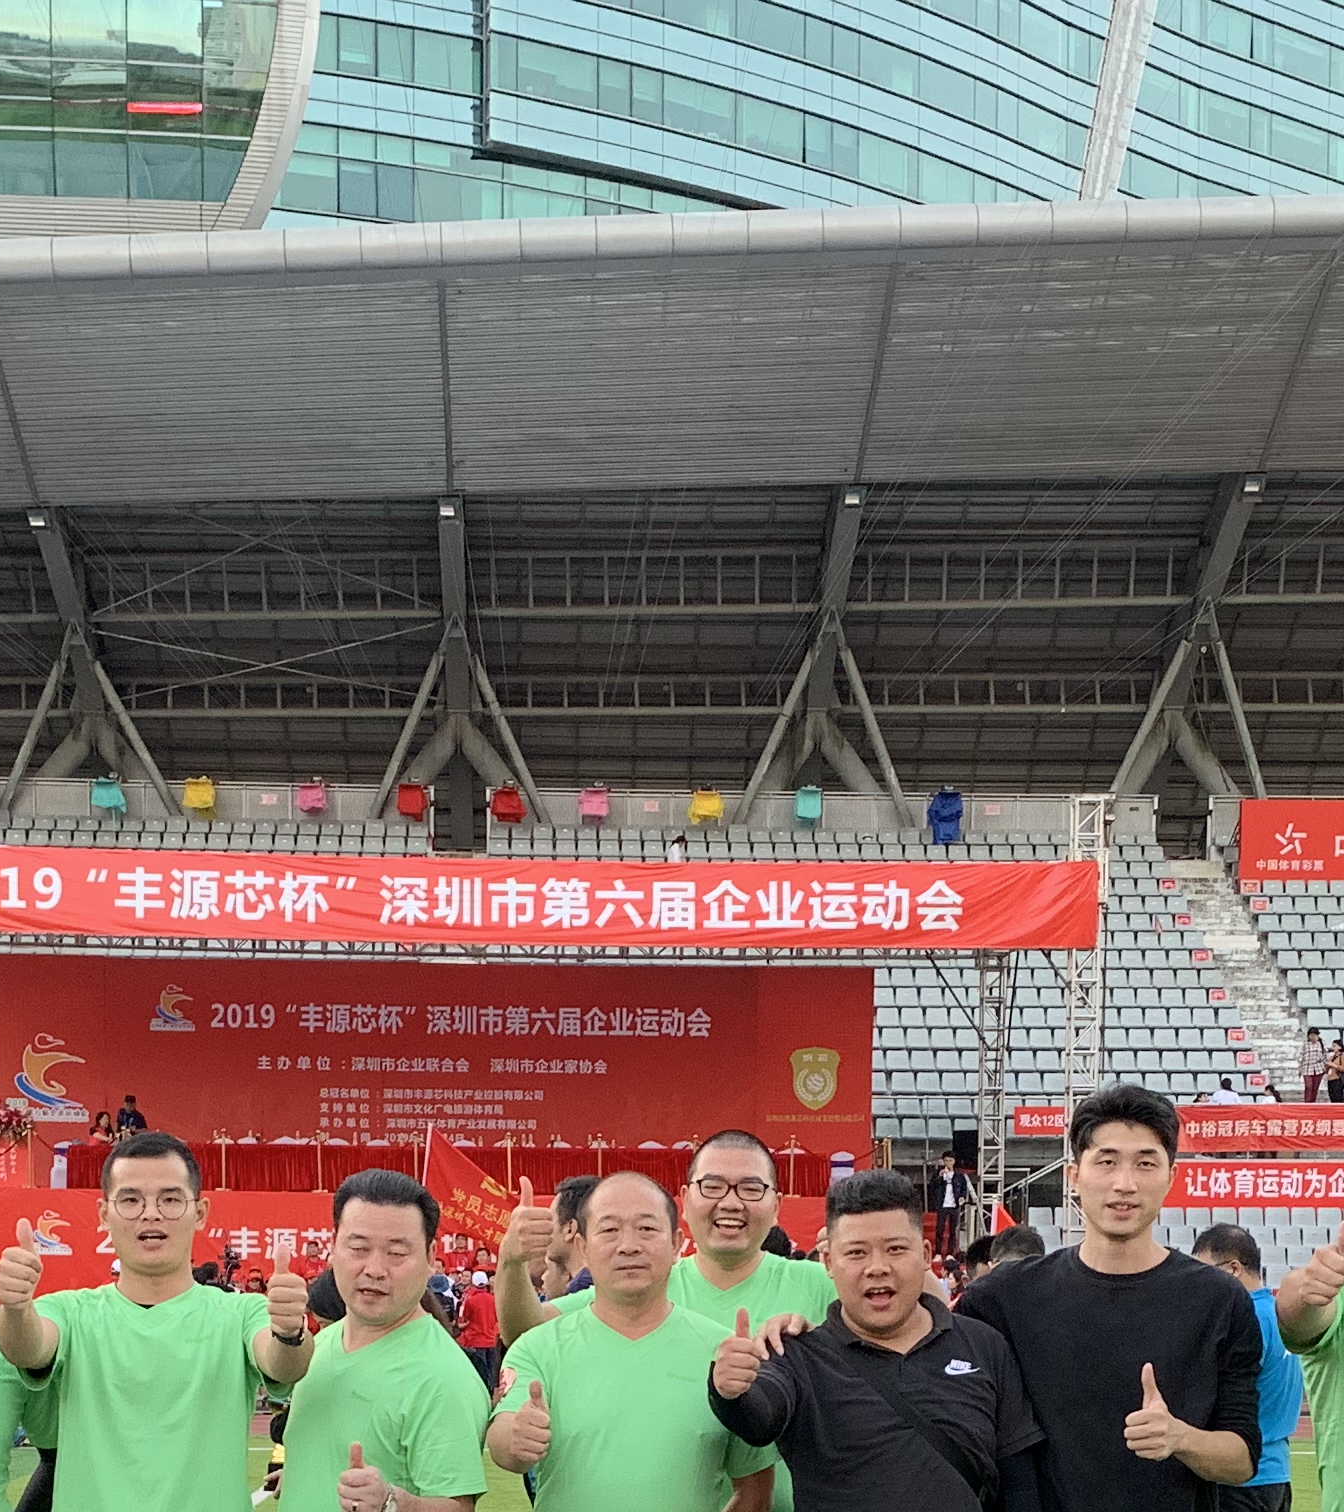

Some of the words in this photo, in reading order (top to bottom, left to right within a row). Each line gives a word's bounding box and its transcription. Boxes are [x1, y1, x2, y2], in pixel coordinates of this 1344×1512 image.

[1256, 859, 1324, 872] 中国体育彩票
[378, 875, 965, 932] 深圳市第六届企业运动会
[210, 1003, 275, 1029] 2019
[426, 1005, 713, 1038] 深圳市第六届企业运动会
[489, 1058, 608, 1075] 深圳市企业家协会
[1019, 1113, 1065, 1127] 观众12区
[949, 1359, 972, 1371] NIKE
